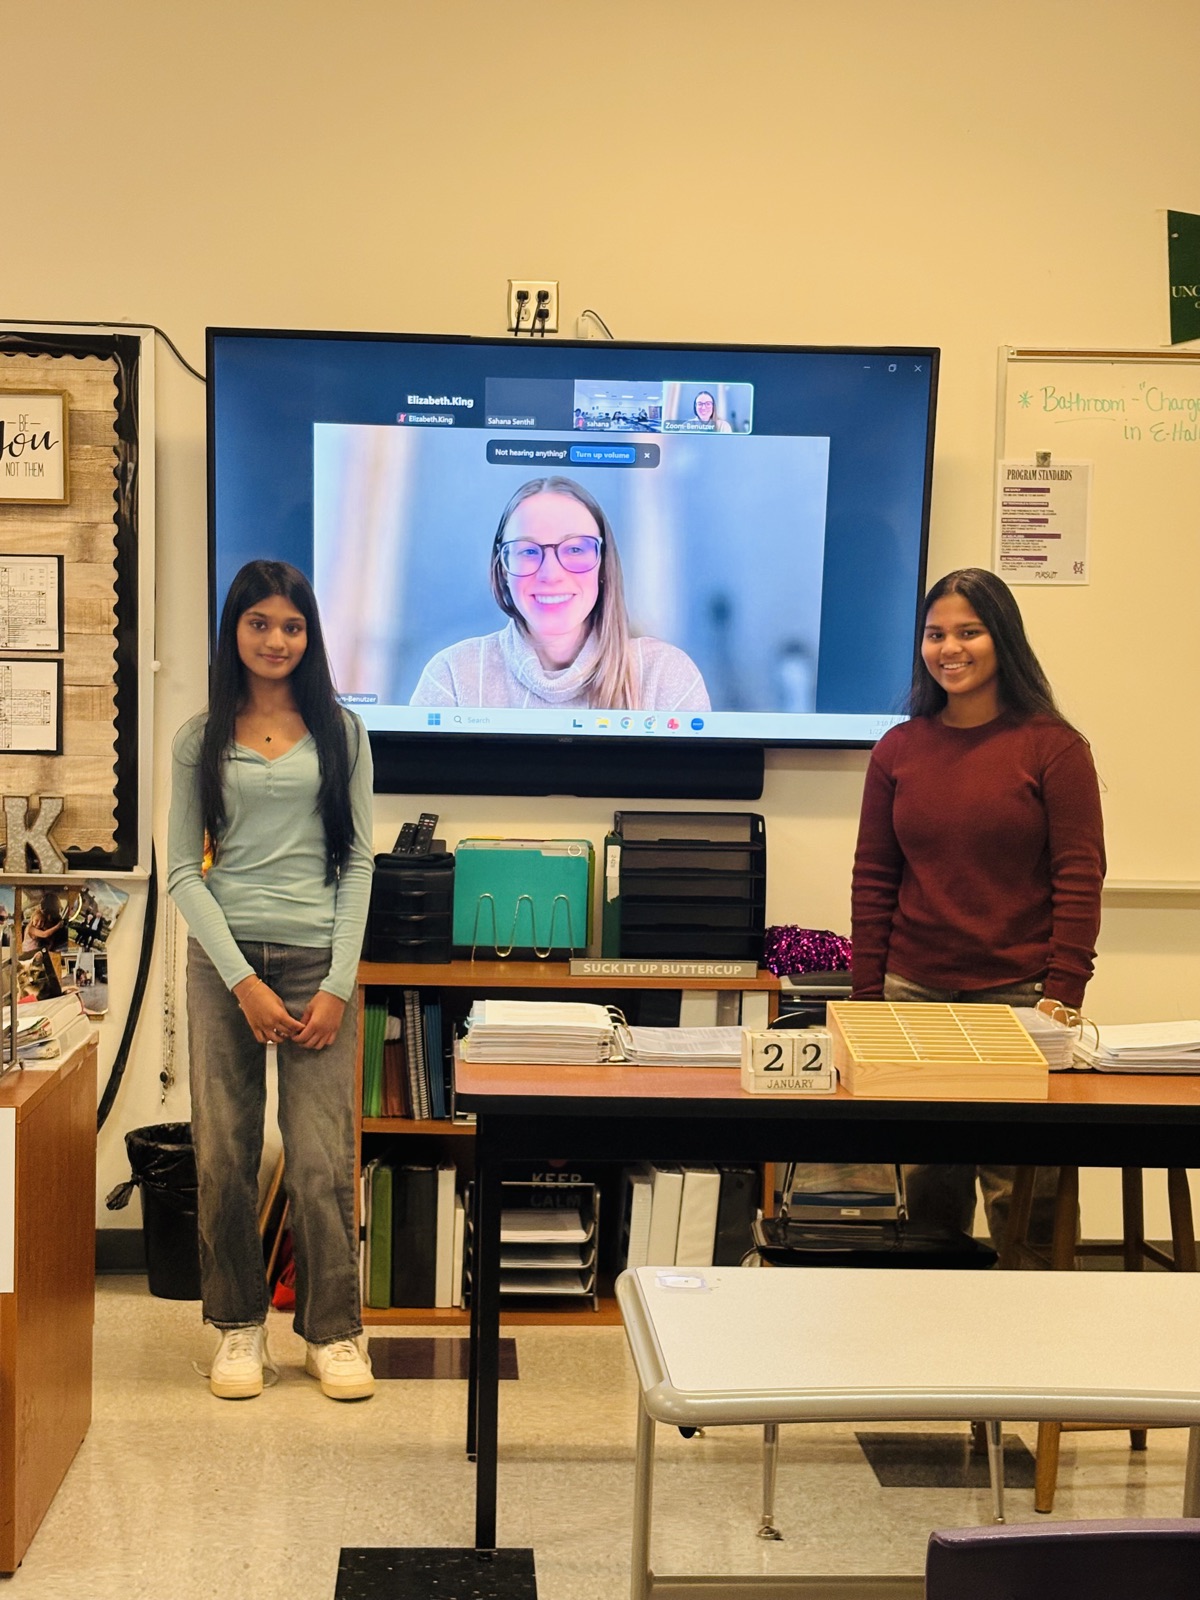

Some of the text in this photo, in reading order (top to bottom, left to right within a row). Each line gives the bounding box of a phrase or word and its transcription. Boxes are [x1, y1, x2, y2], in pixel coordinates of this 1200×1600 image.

[407, 395, 474, 408] Elizabeth.King
[1040, 386, 1125, 412] Bathroom
[19, 414, 29, 432] BE
[408, 415, 453, 425] Elizabeth.King
[487, 417, 511, 425] Sahana
[665, 422, 715, 430] Zoom-Benutzer
[1124, 419, 1141, 441] in
[495, 448, 567, 459] Not hearing anything?
[576, 451, 591, 459] Turn
[604, 452, 630, 460] volume
[5, 461, 44, 477] NOT THEM
[1007, 469, 1072, 481] PROGRAM STANDARDS
[3, 795, 69, 874] K
[583, 963, 742, 975] SUCK IT UP BUTTERCUP
[767, 1079, 814, 1089] JANUARY
[531, 1172, 582, 1188] KEEP
